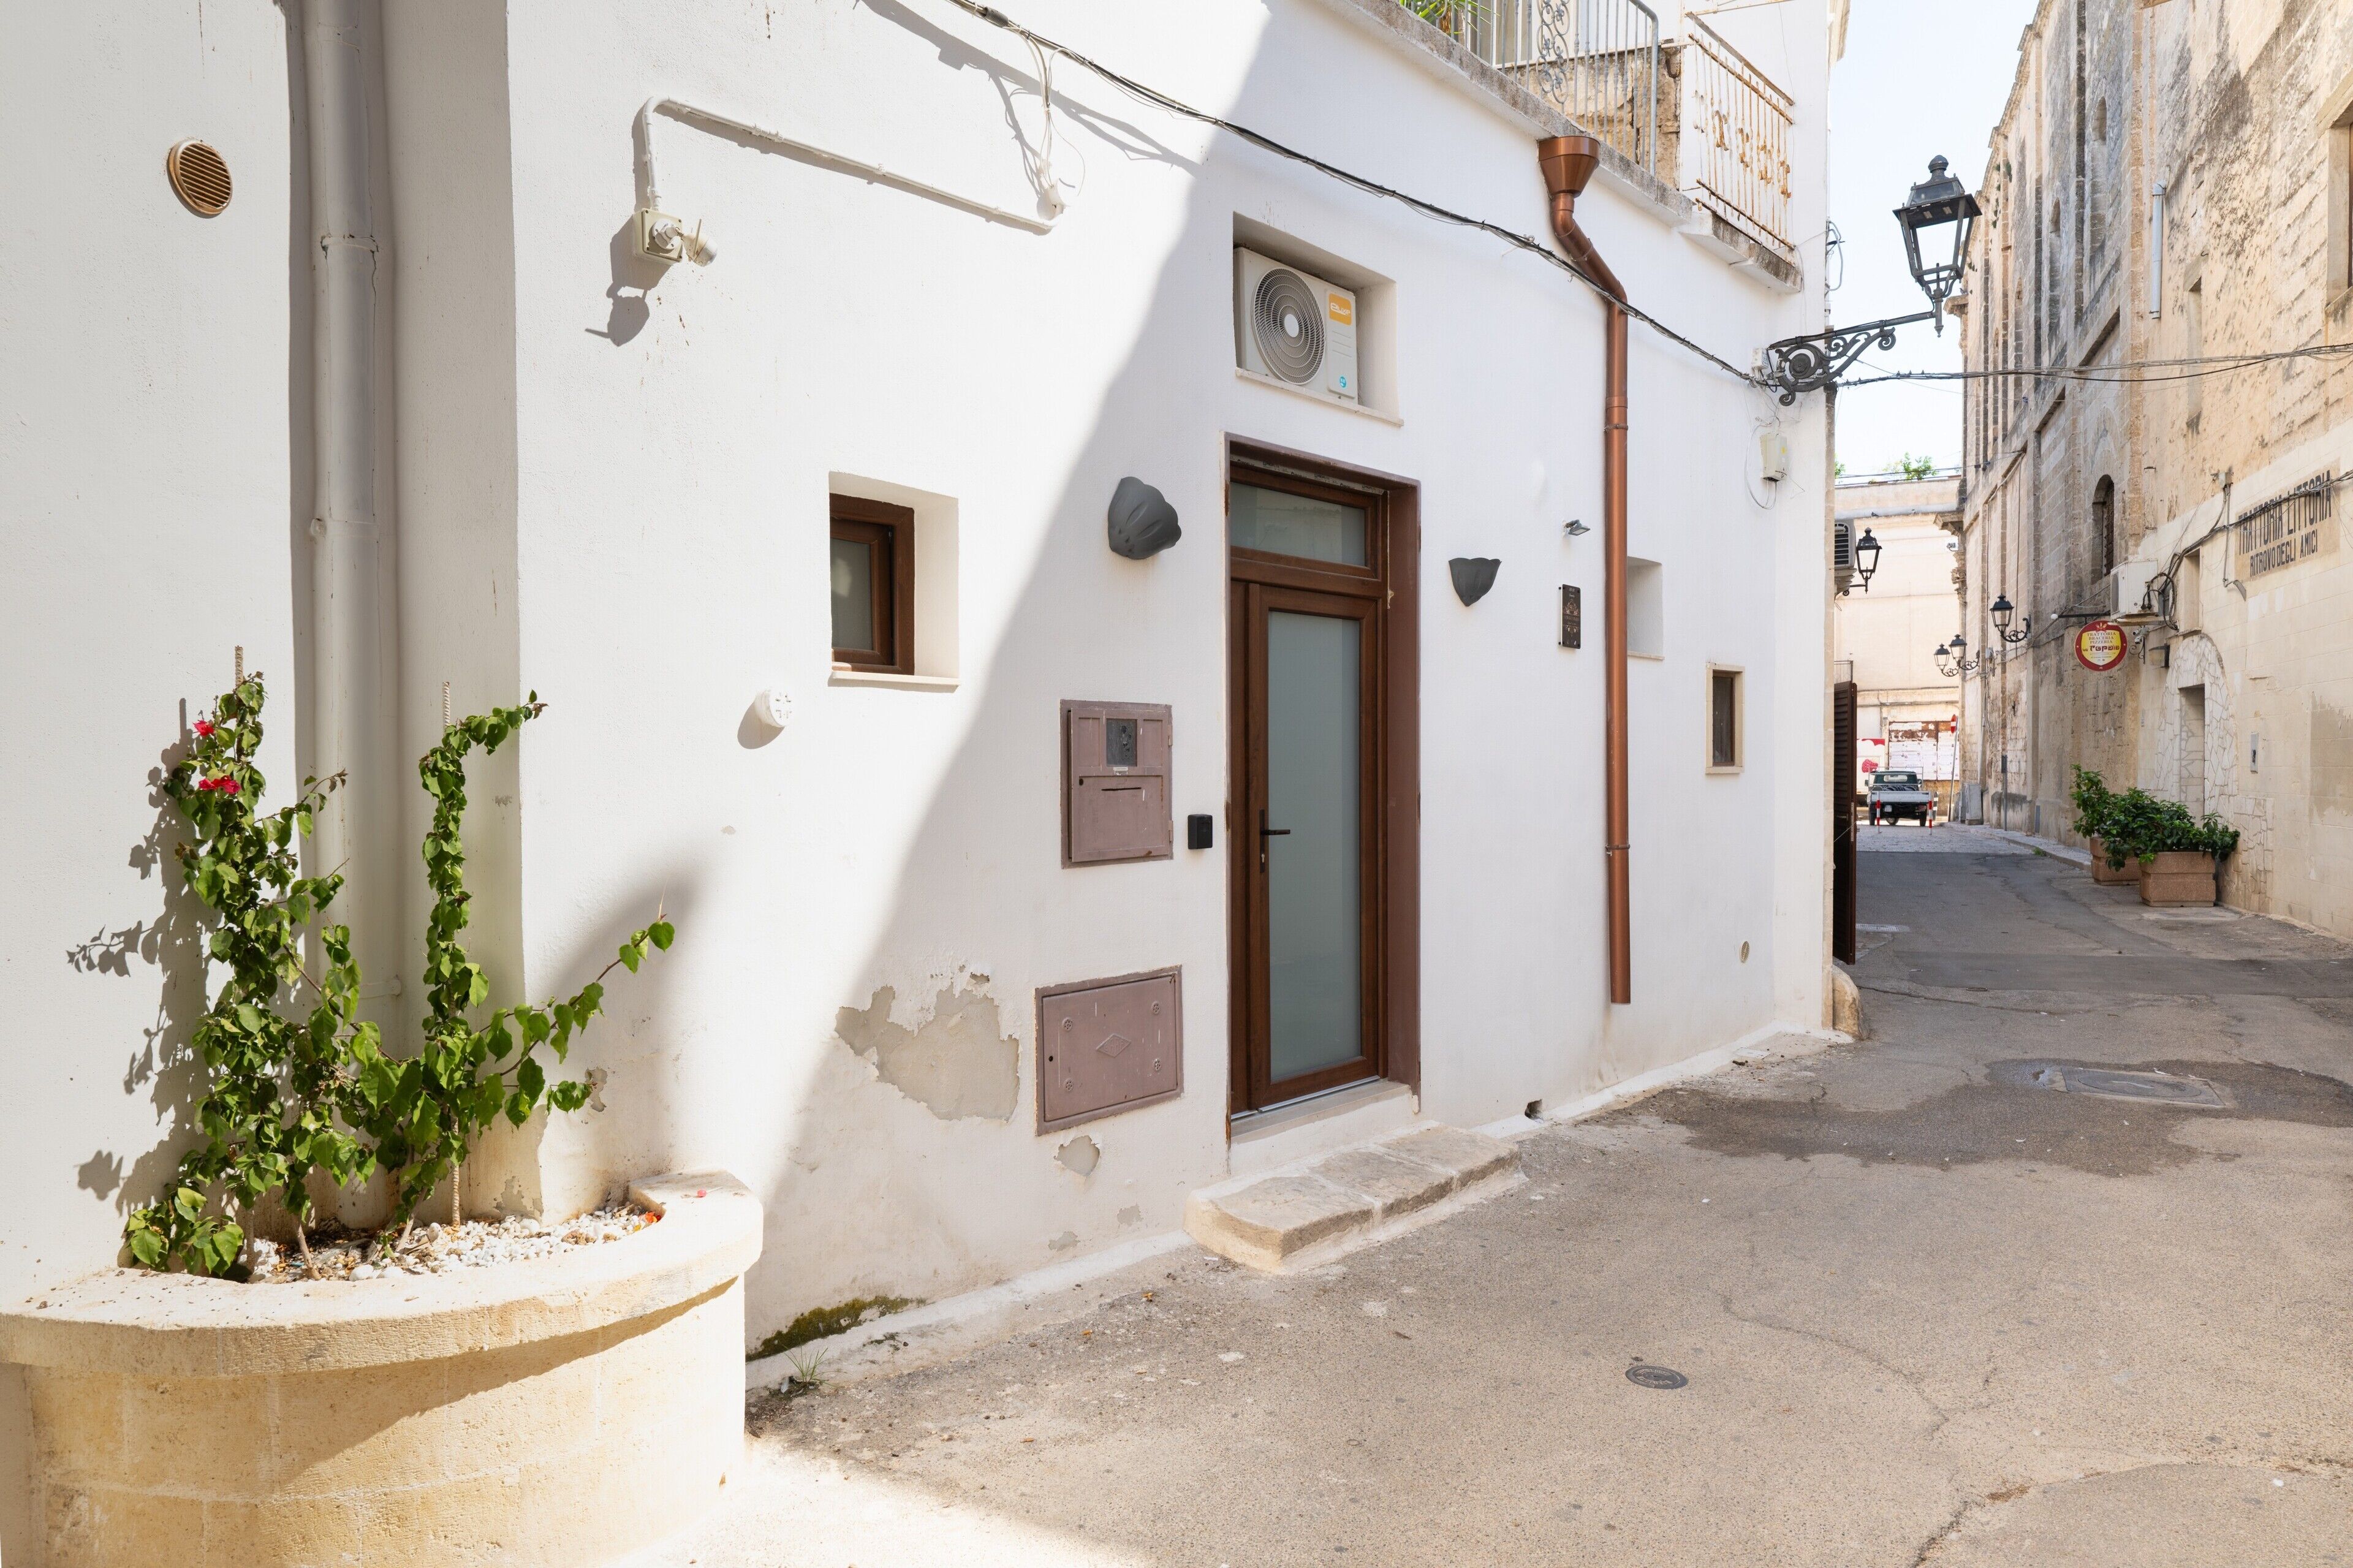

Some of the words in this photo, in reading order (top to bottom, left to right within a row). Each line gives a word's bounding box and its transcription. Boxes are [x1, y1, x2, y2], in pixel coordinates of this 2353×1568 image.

[2238, 494, 2283, 556] TRATTORIA
[2287, 469, 2332, 536] LITTORIA
[2250, 547, 2276, 577] RITROVO
[2276, 538, 2296, 567] DEGLI
[2300, 529, 2318, 558] AMICI
